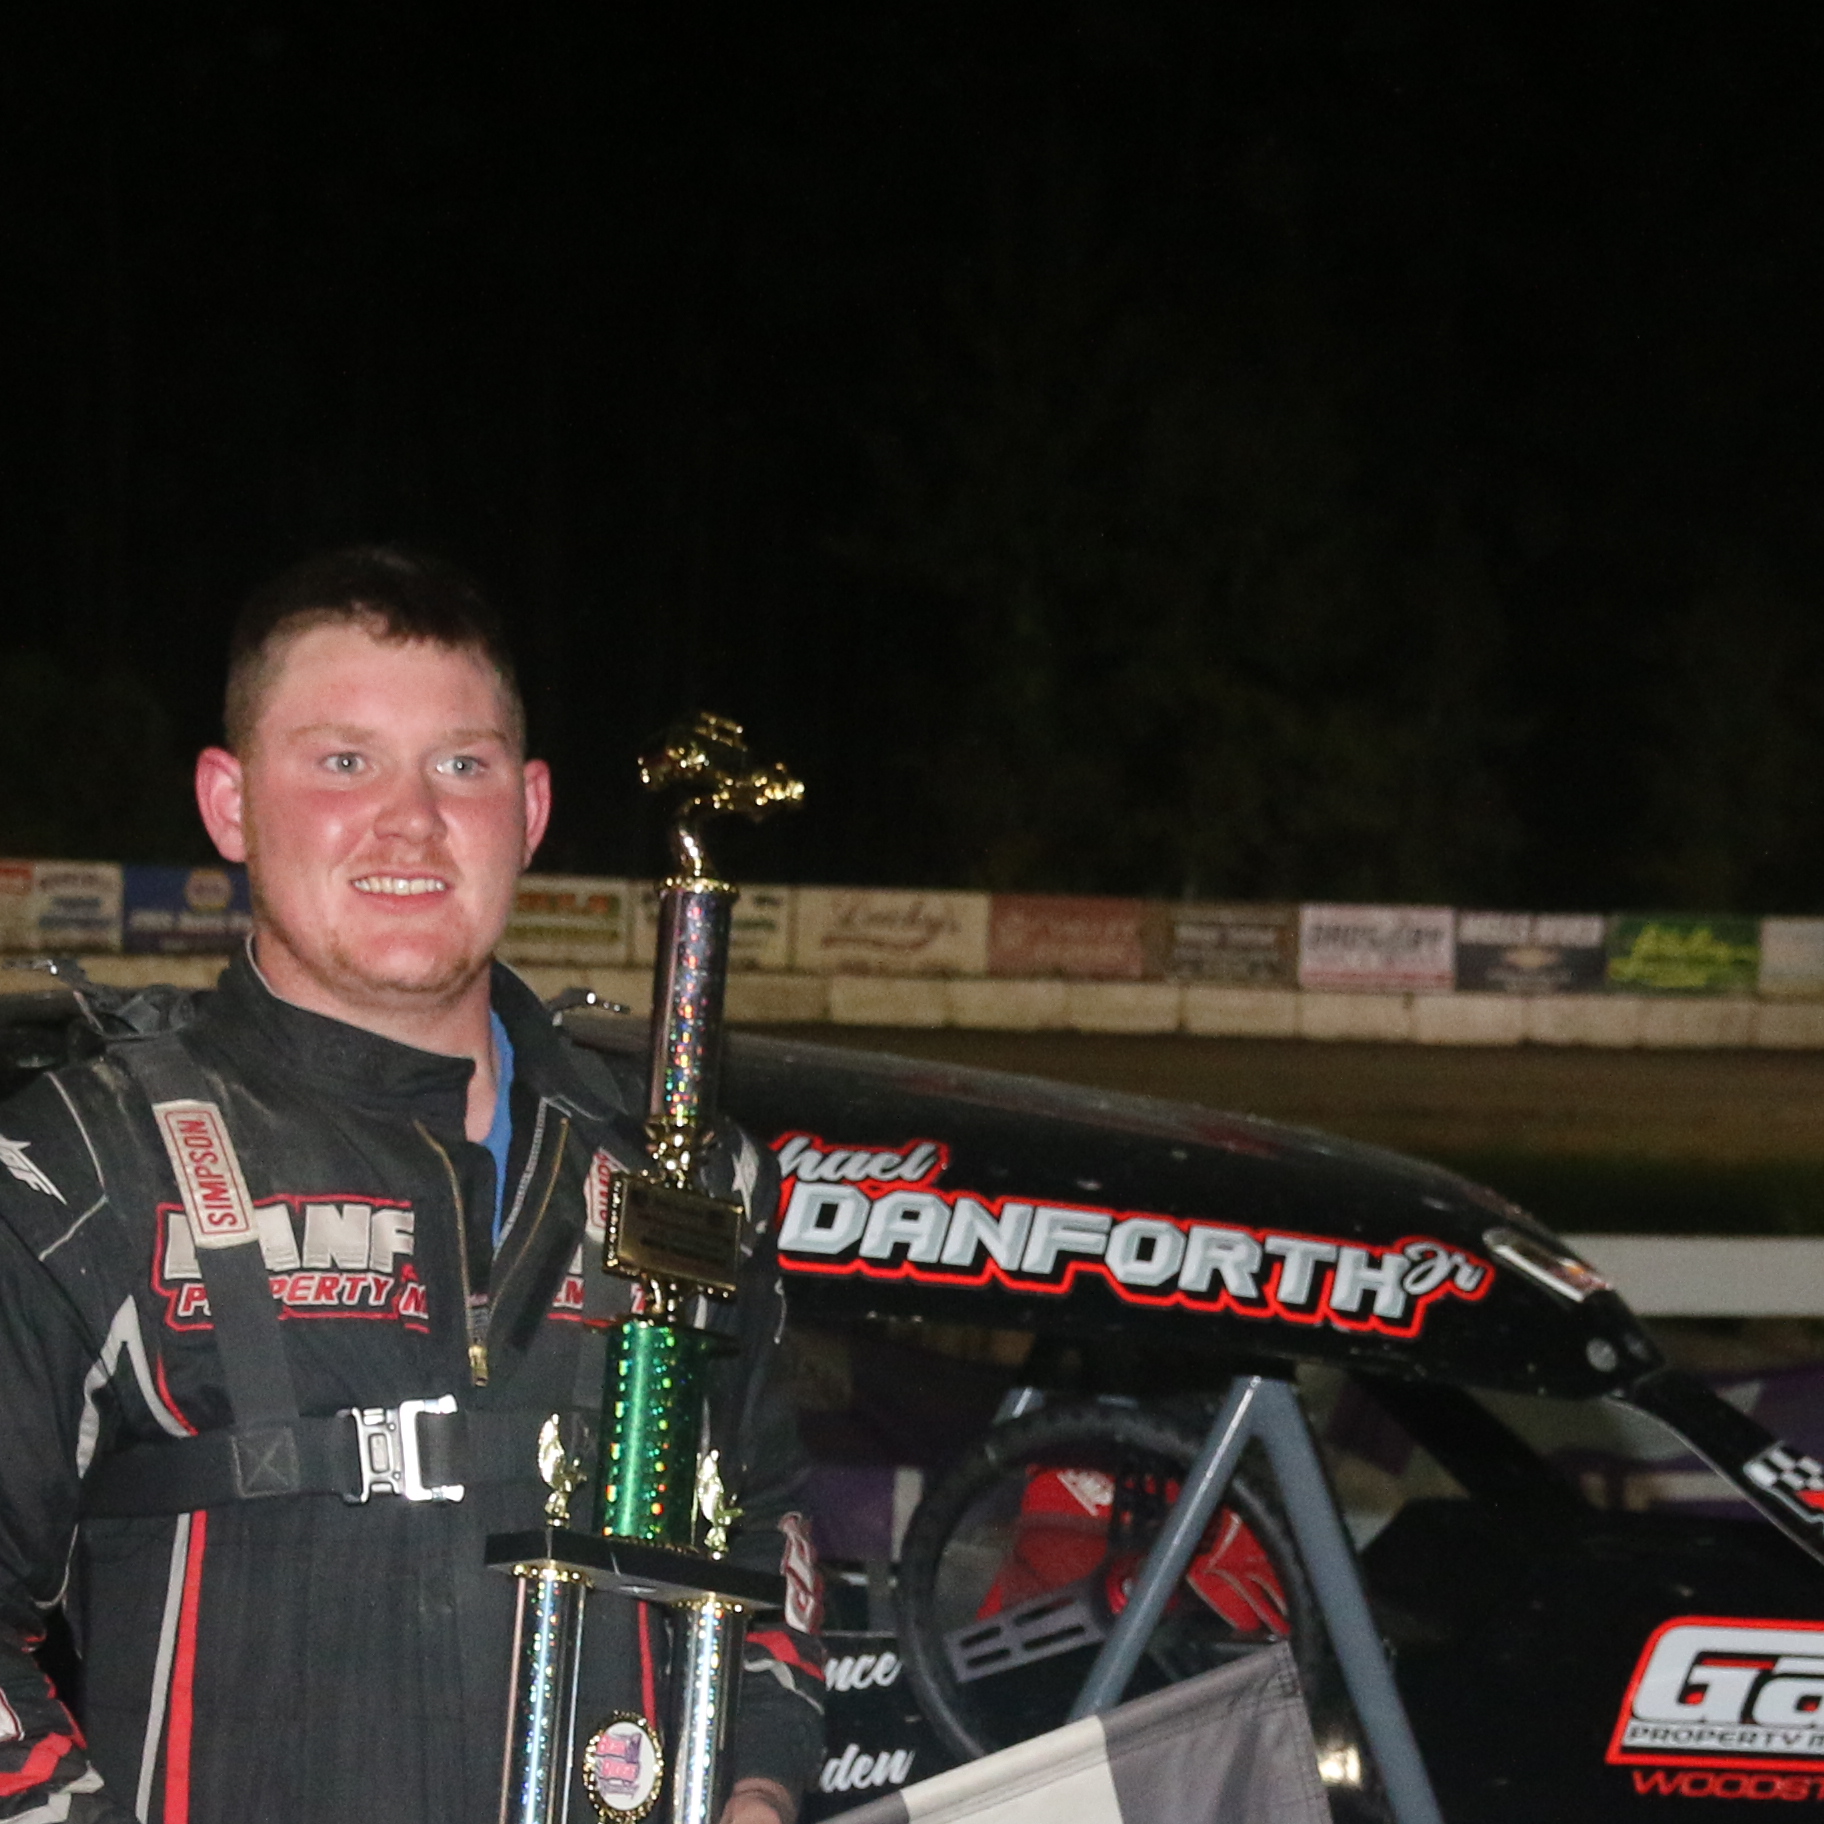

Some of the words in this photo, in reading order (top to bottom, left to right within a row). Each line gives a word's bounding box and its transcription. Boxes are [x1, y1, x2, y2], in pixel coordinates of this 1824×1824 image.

[176, 1119, 238, 1230] SIMPSON
[776, 1134, 940, 1183] hael
[776, 1180, 1412, 1320] DANFORTH
[1626, 1723, 1805, 1750] PROPERTY
